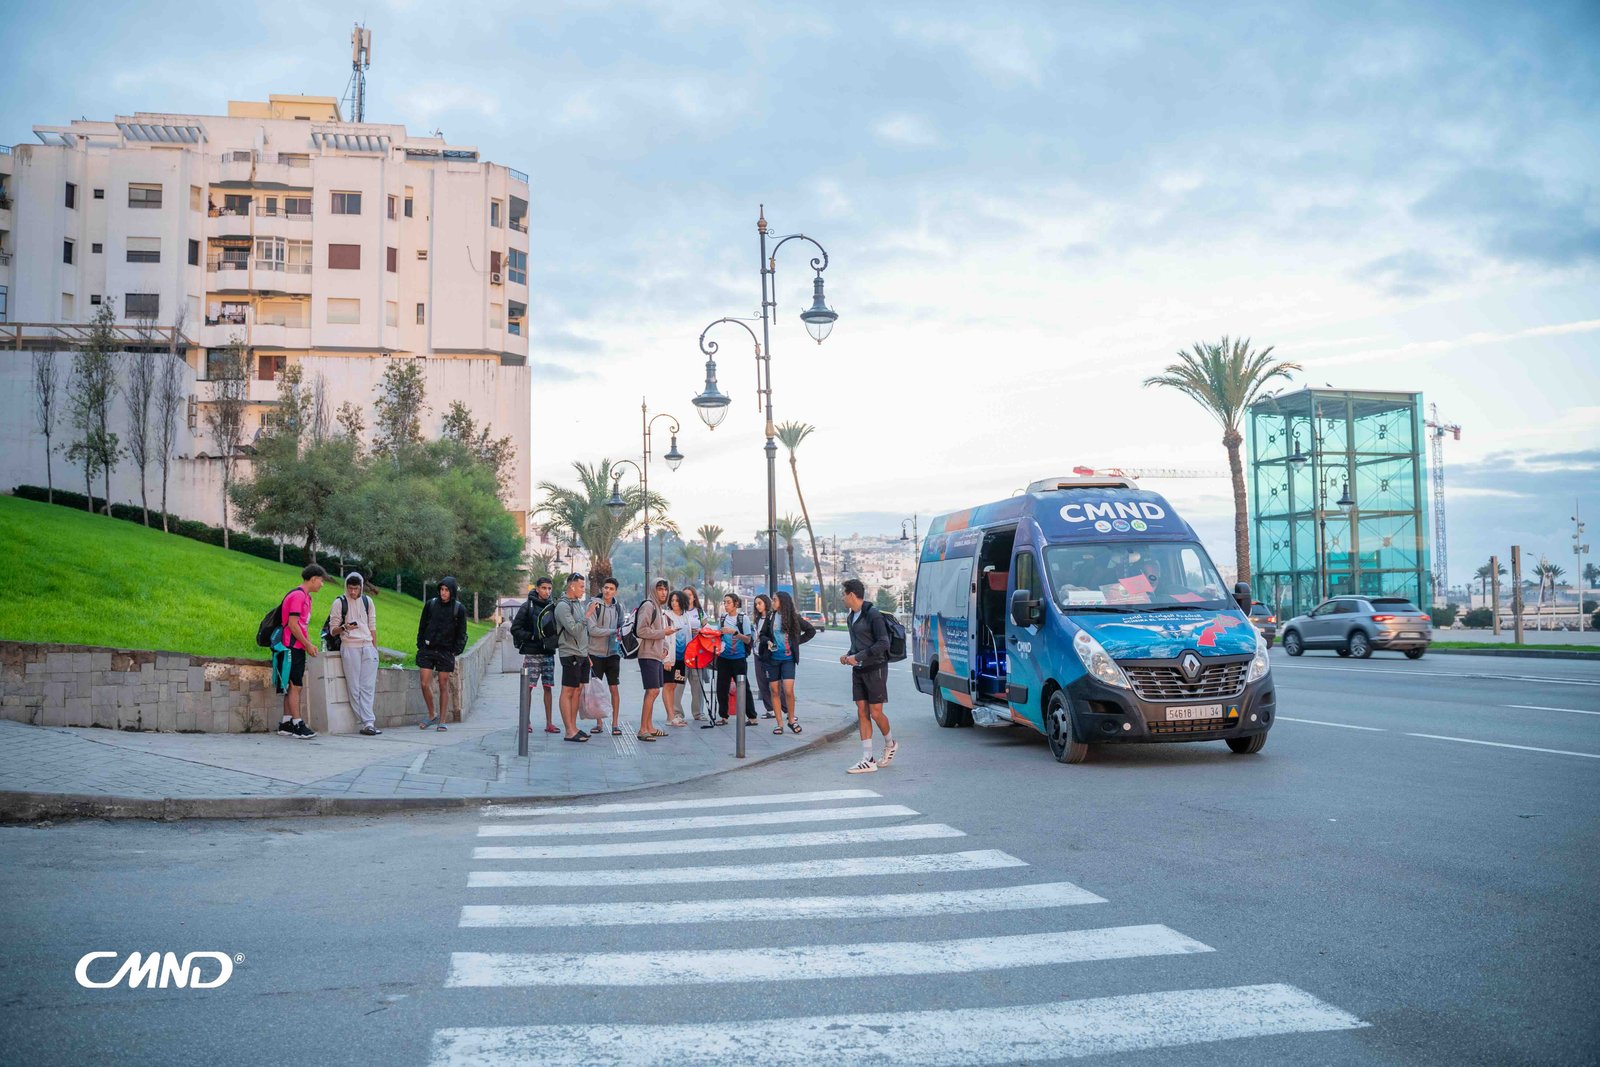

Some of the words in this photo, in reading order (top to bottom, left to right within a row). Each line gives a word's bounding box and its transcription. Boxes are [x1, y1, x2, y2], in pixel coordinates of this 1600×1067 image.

[1060, 502, 1165, 522] CMND
[1017, 641, 1032, 653] CMND
[1210, 706, 1219, 716] 34
